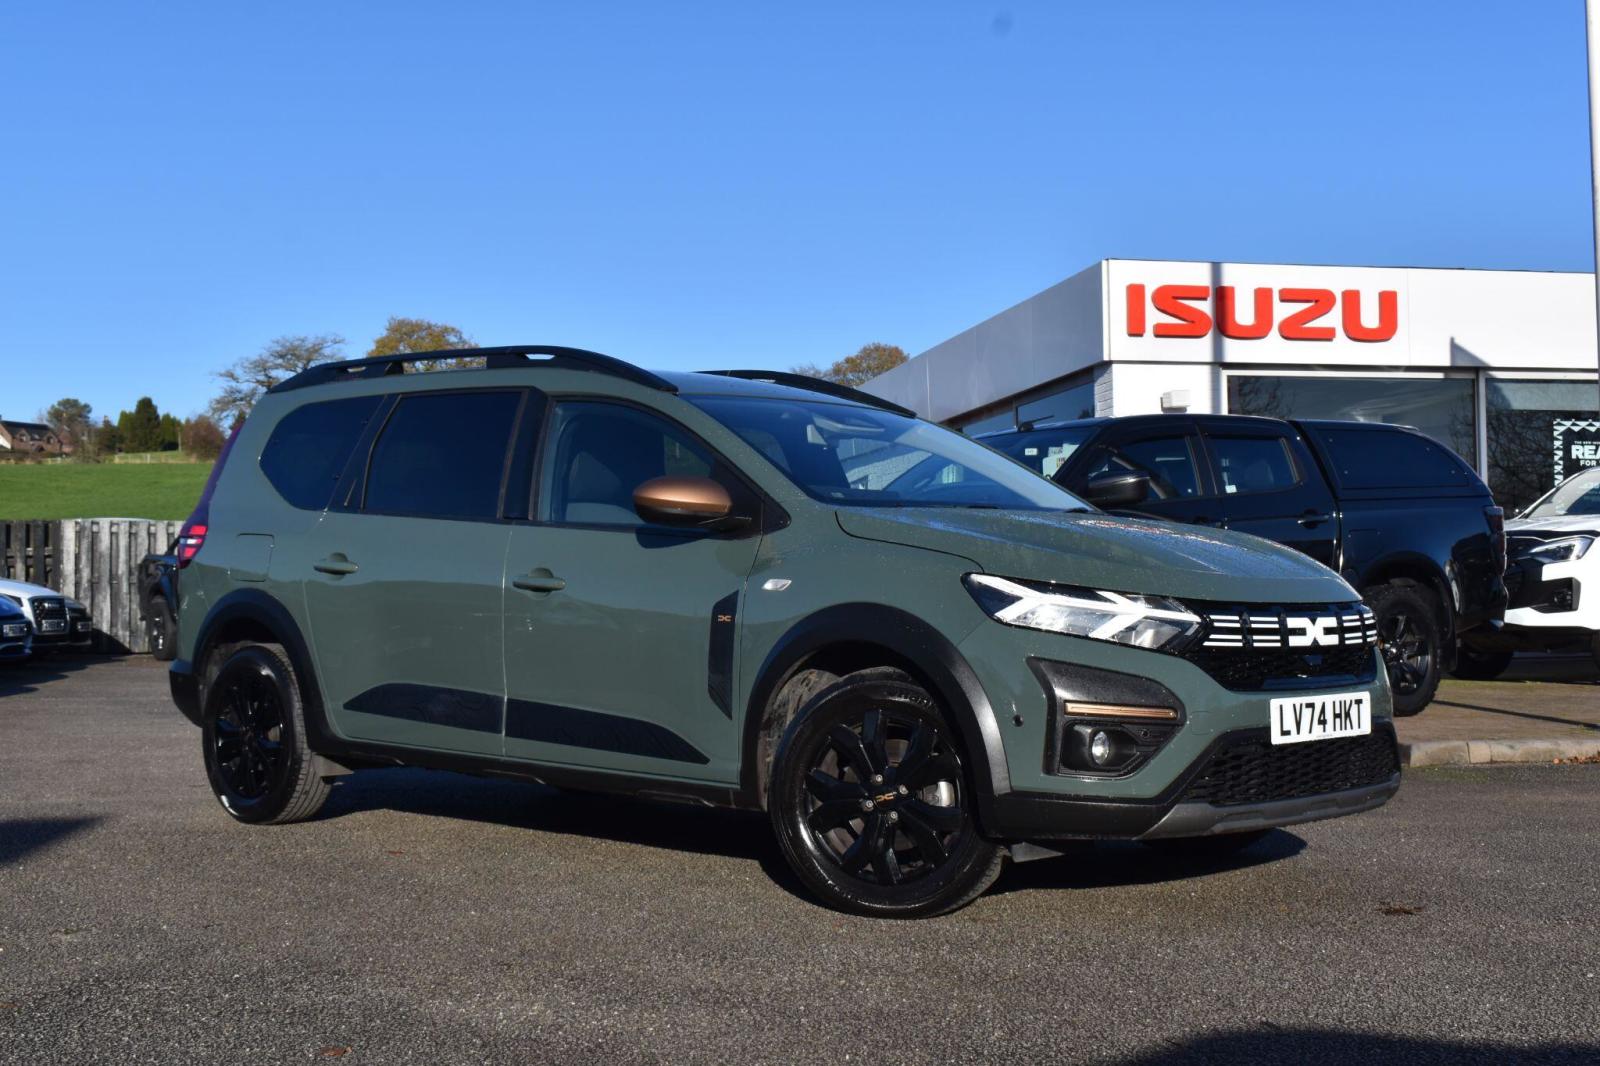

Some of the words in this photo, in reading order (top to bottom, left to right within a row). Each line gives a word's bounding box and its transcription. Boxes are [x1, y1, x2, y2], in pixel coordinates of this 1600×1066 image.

[1126, 283, 1398, 342] ISUZU
[1279, 701, 1328, 736] LV74
[1333, 699, 1363, 731] HKT
